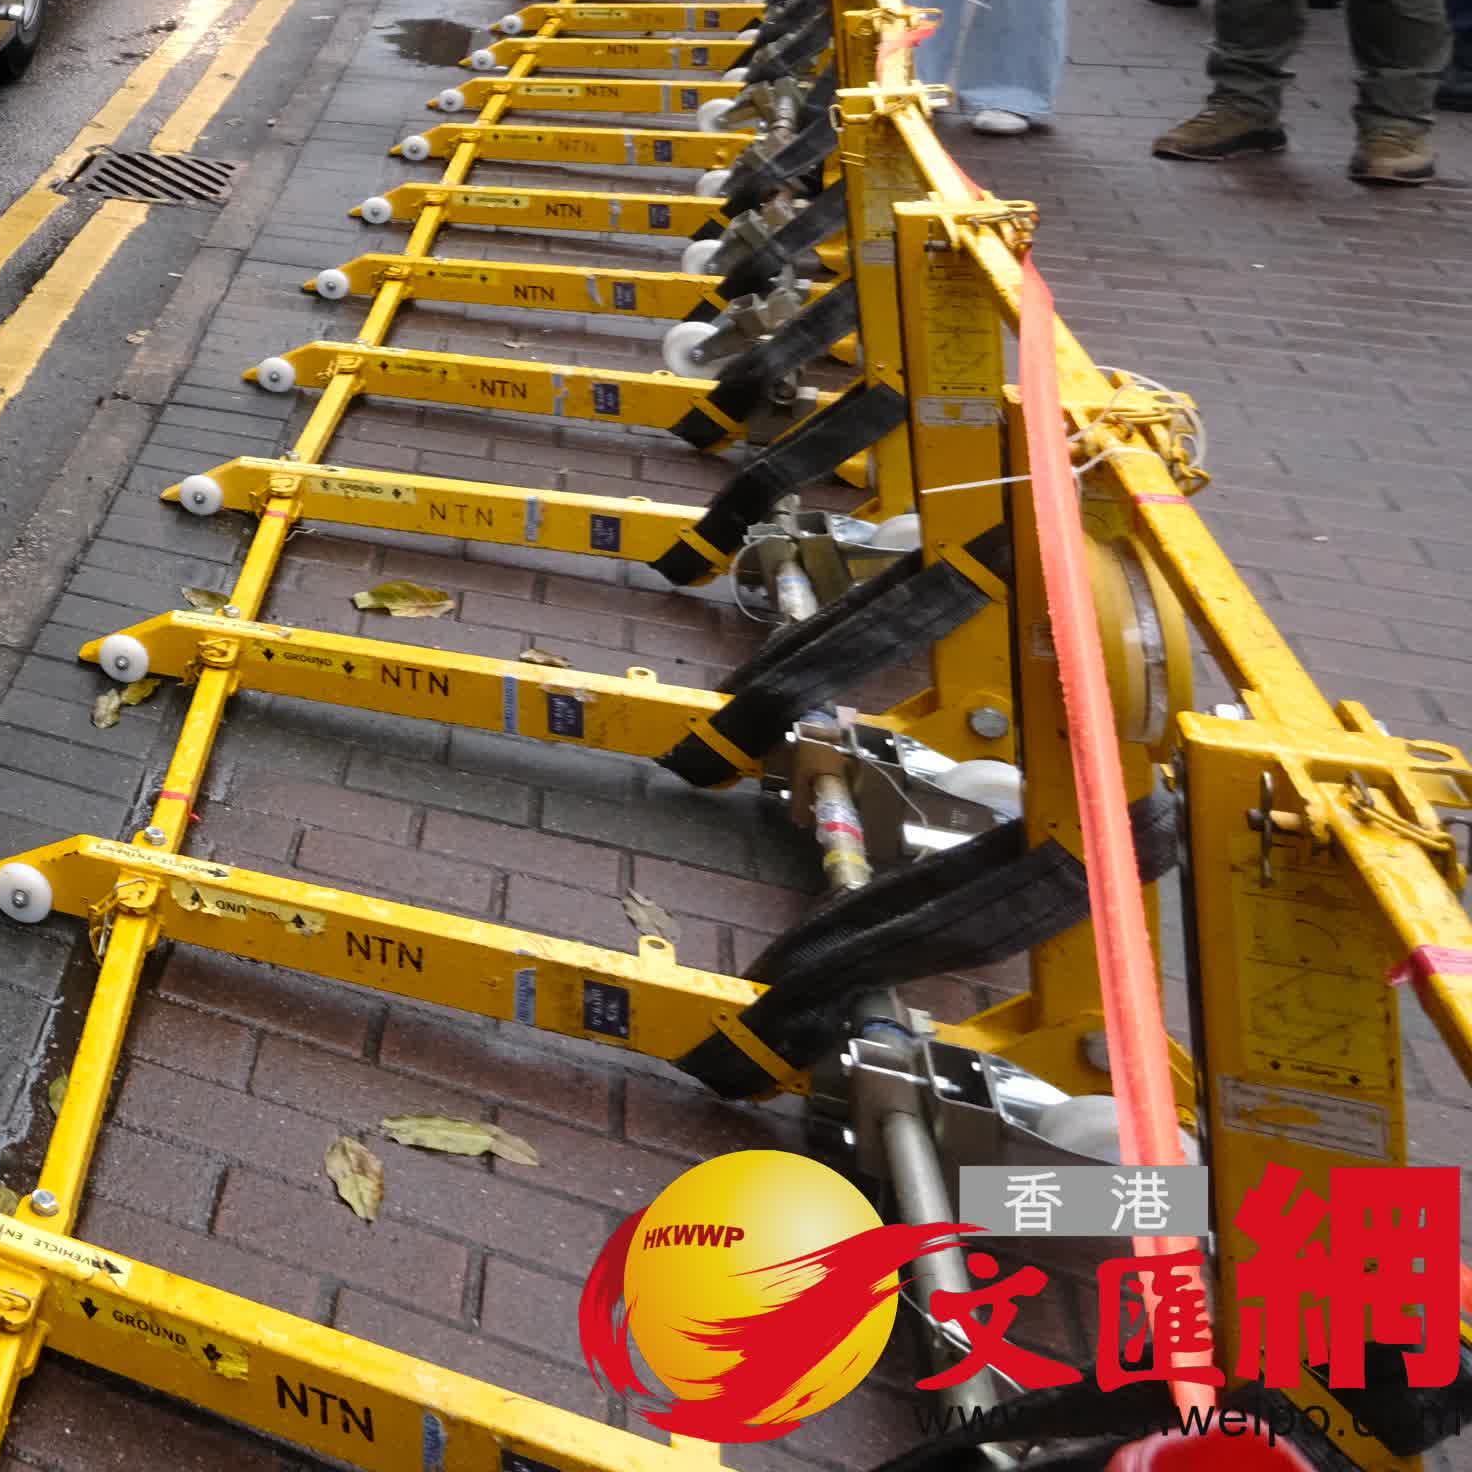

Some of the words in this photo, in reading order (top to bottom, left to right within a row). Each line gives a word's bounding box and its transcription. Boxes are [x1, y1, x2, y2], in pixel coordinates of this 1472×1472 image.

[545, 203, 583, 219] NTN
[513, 284, 556, 302] NTN
[480, 378, 528, 399] NTN
[429, 502, 495, 527] NTN
[283, 651, 333, 667] GROUND
[381, 663, 449, 696] NTN
[345, 930, 424, 974] NTN
[33, 1238, 92, 1268] VEHICLE
[112, 1309, 187, 1347] GROUND
[276, 1374, 376, 1443] NTN
